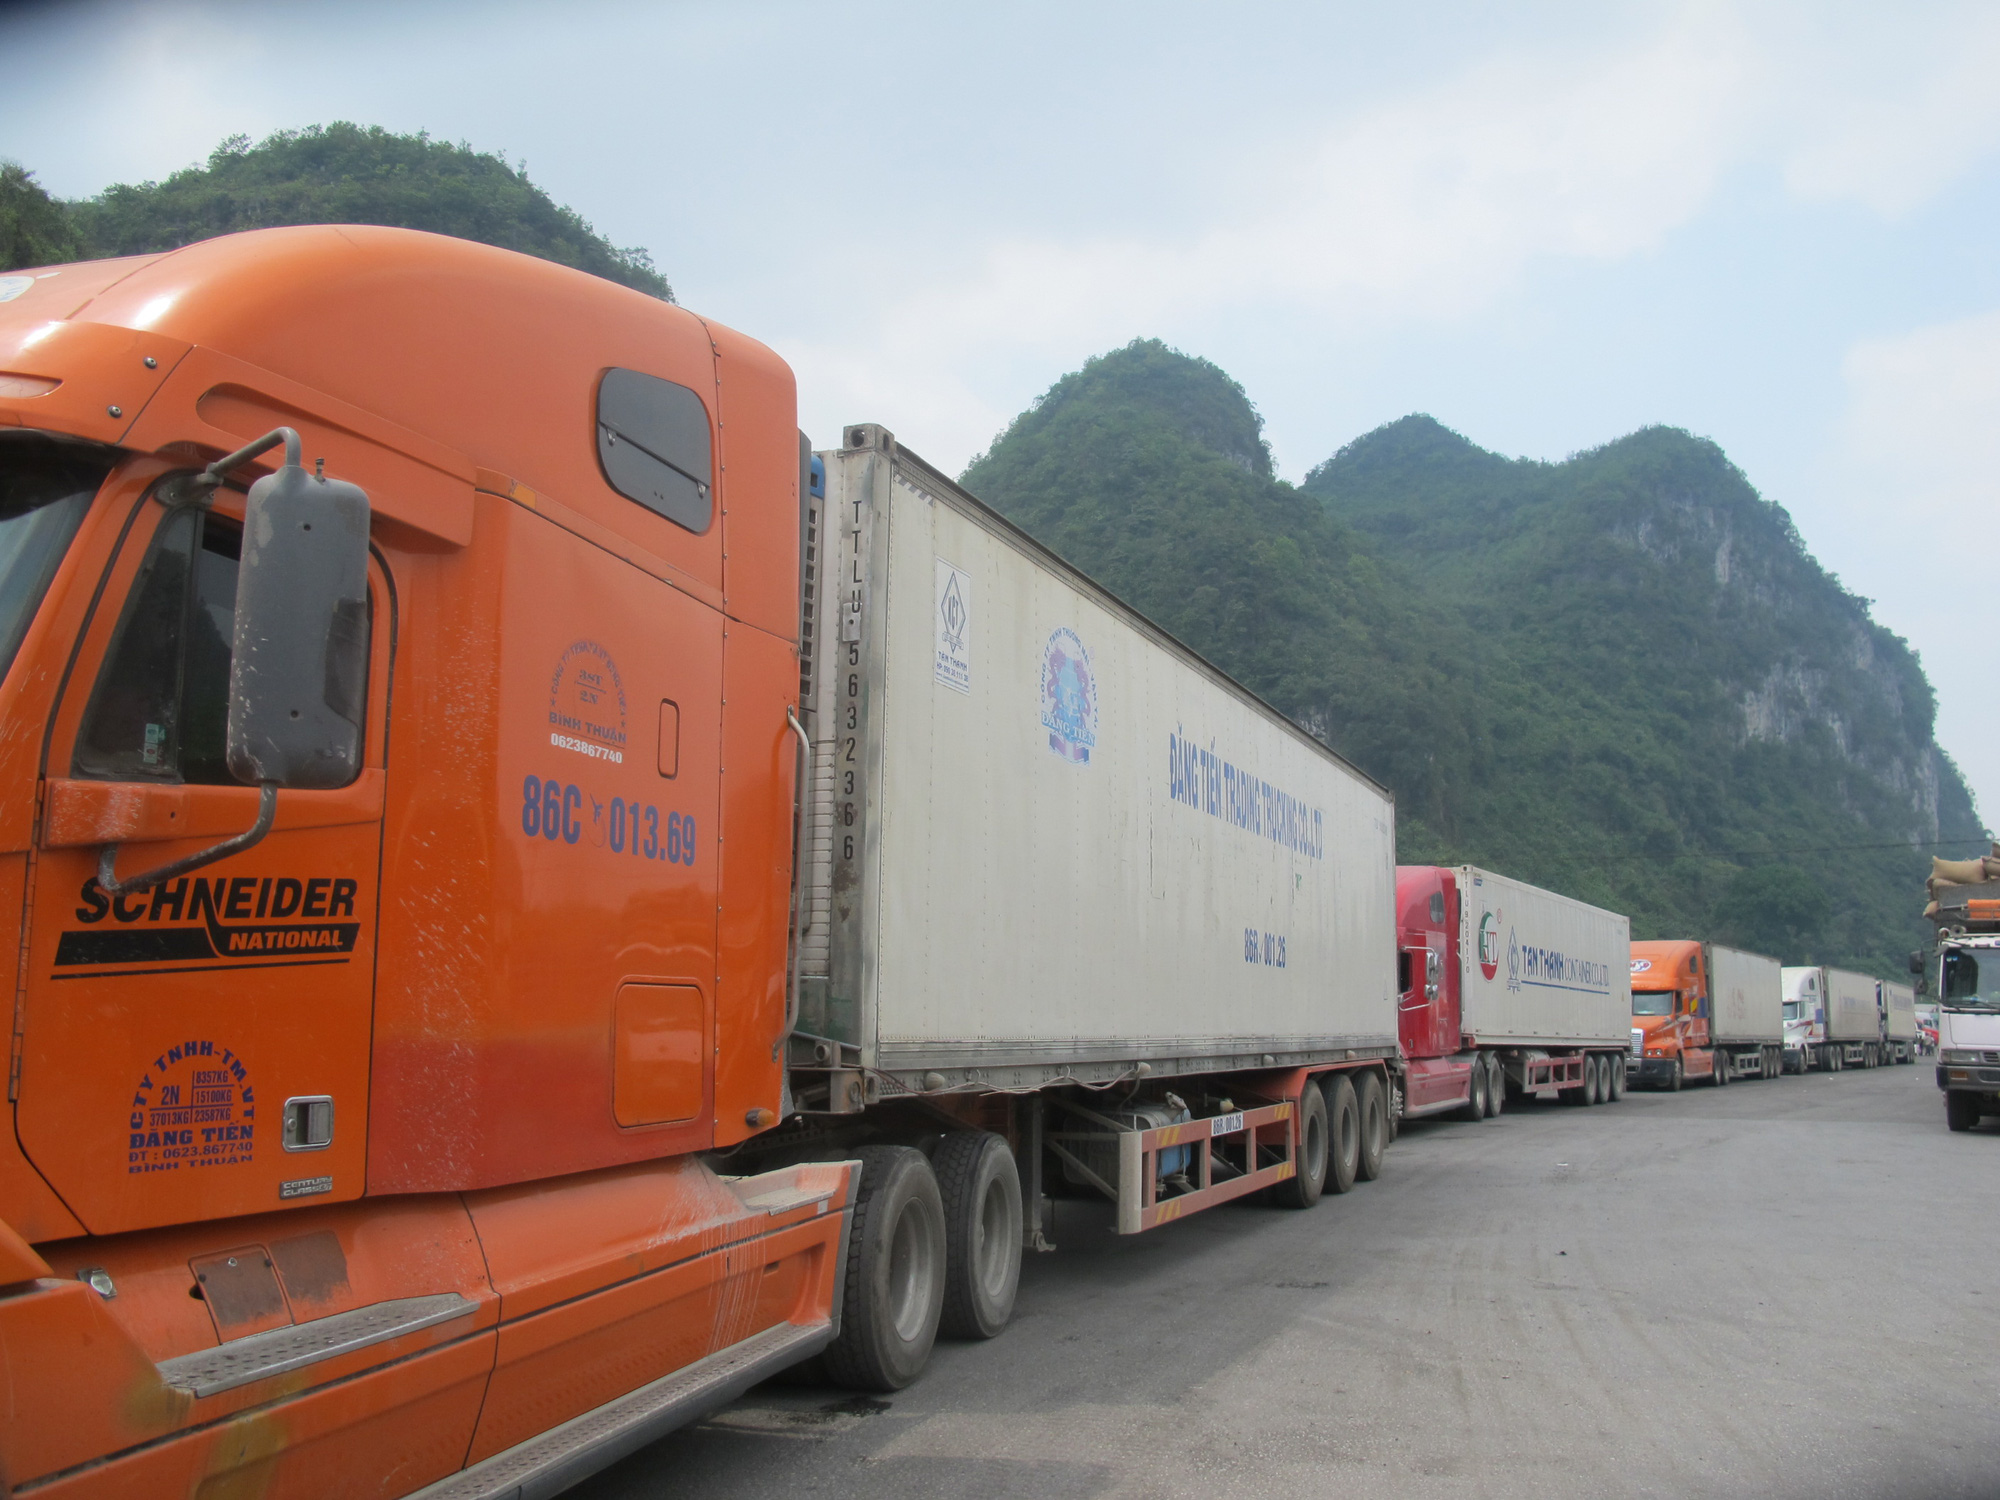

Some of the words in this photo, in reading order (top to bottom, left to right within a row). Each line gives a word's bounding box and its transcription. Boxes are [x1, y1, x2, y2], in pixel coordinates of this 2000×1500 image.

[851, 500, 863, 614] TTLU
[550, 733, 623, 764] 0623867740
[1223, 761, 1261, 837] TRADING
[1261, 780, 1298, 853] TRUCKING
[522, 774, 582, 845] 86C
[609, 796, 696, 867] 013.69
[75, 876, 358, 924] SCHNEIDER
[228, 929, 343, 951] NATIONAL
[195, 1070, 229, 1084] 8357KG
[161, 1085, 180, 1106] 2N
[149, 1109, 190, 1127] 37013KG
[129, 1127, 194, 1150] ĐĂNG
[283, 1176, 333, 1189] CENTURY
